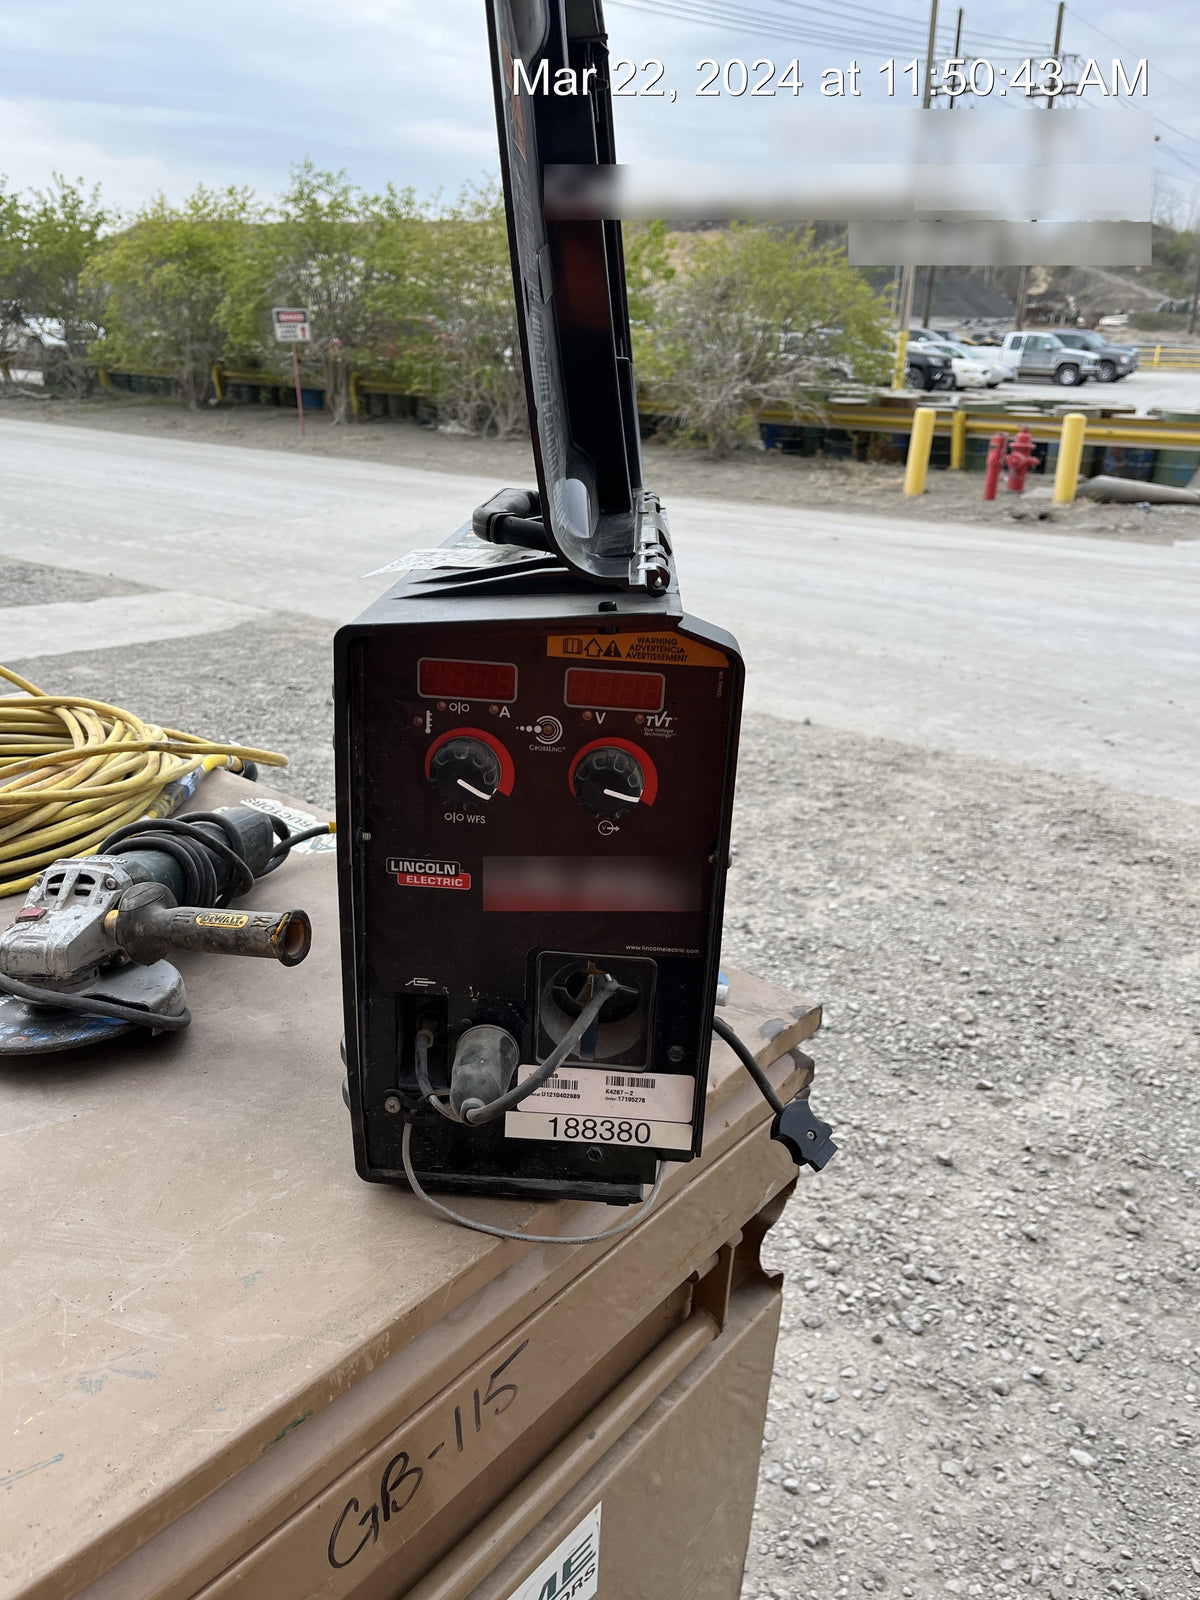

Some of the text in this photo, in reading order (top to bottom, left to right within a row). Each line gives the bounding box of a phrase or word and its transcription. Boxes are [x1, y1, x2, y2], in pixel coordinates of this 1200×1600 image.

[637, 636, 679, 646] WARNING
[629, 643, 686, 654] ADVERTENCIA
[625, 652, 688, 663] AVERTISSEMENT
[499, 705, 511, 719] A
[595, 711, 607, 725] V
[466, 814, 486, 824] WFS
[390, 860, 456, 875] LINCOLN
[406, 875, 464, 887] ELECTRIC
[625, 944, 700, 954] www.lincolnelectric.com
[548, 1116, 651, 1144] 188380
[328, 1338, 530, 1569] GB-115
